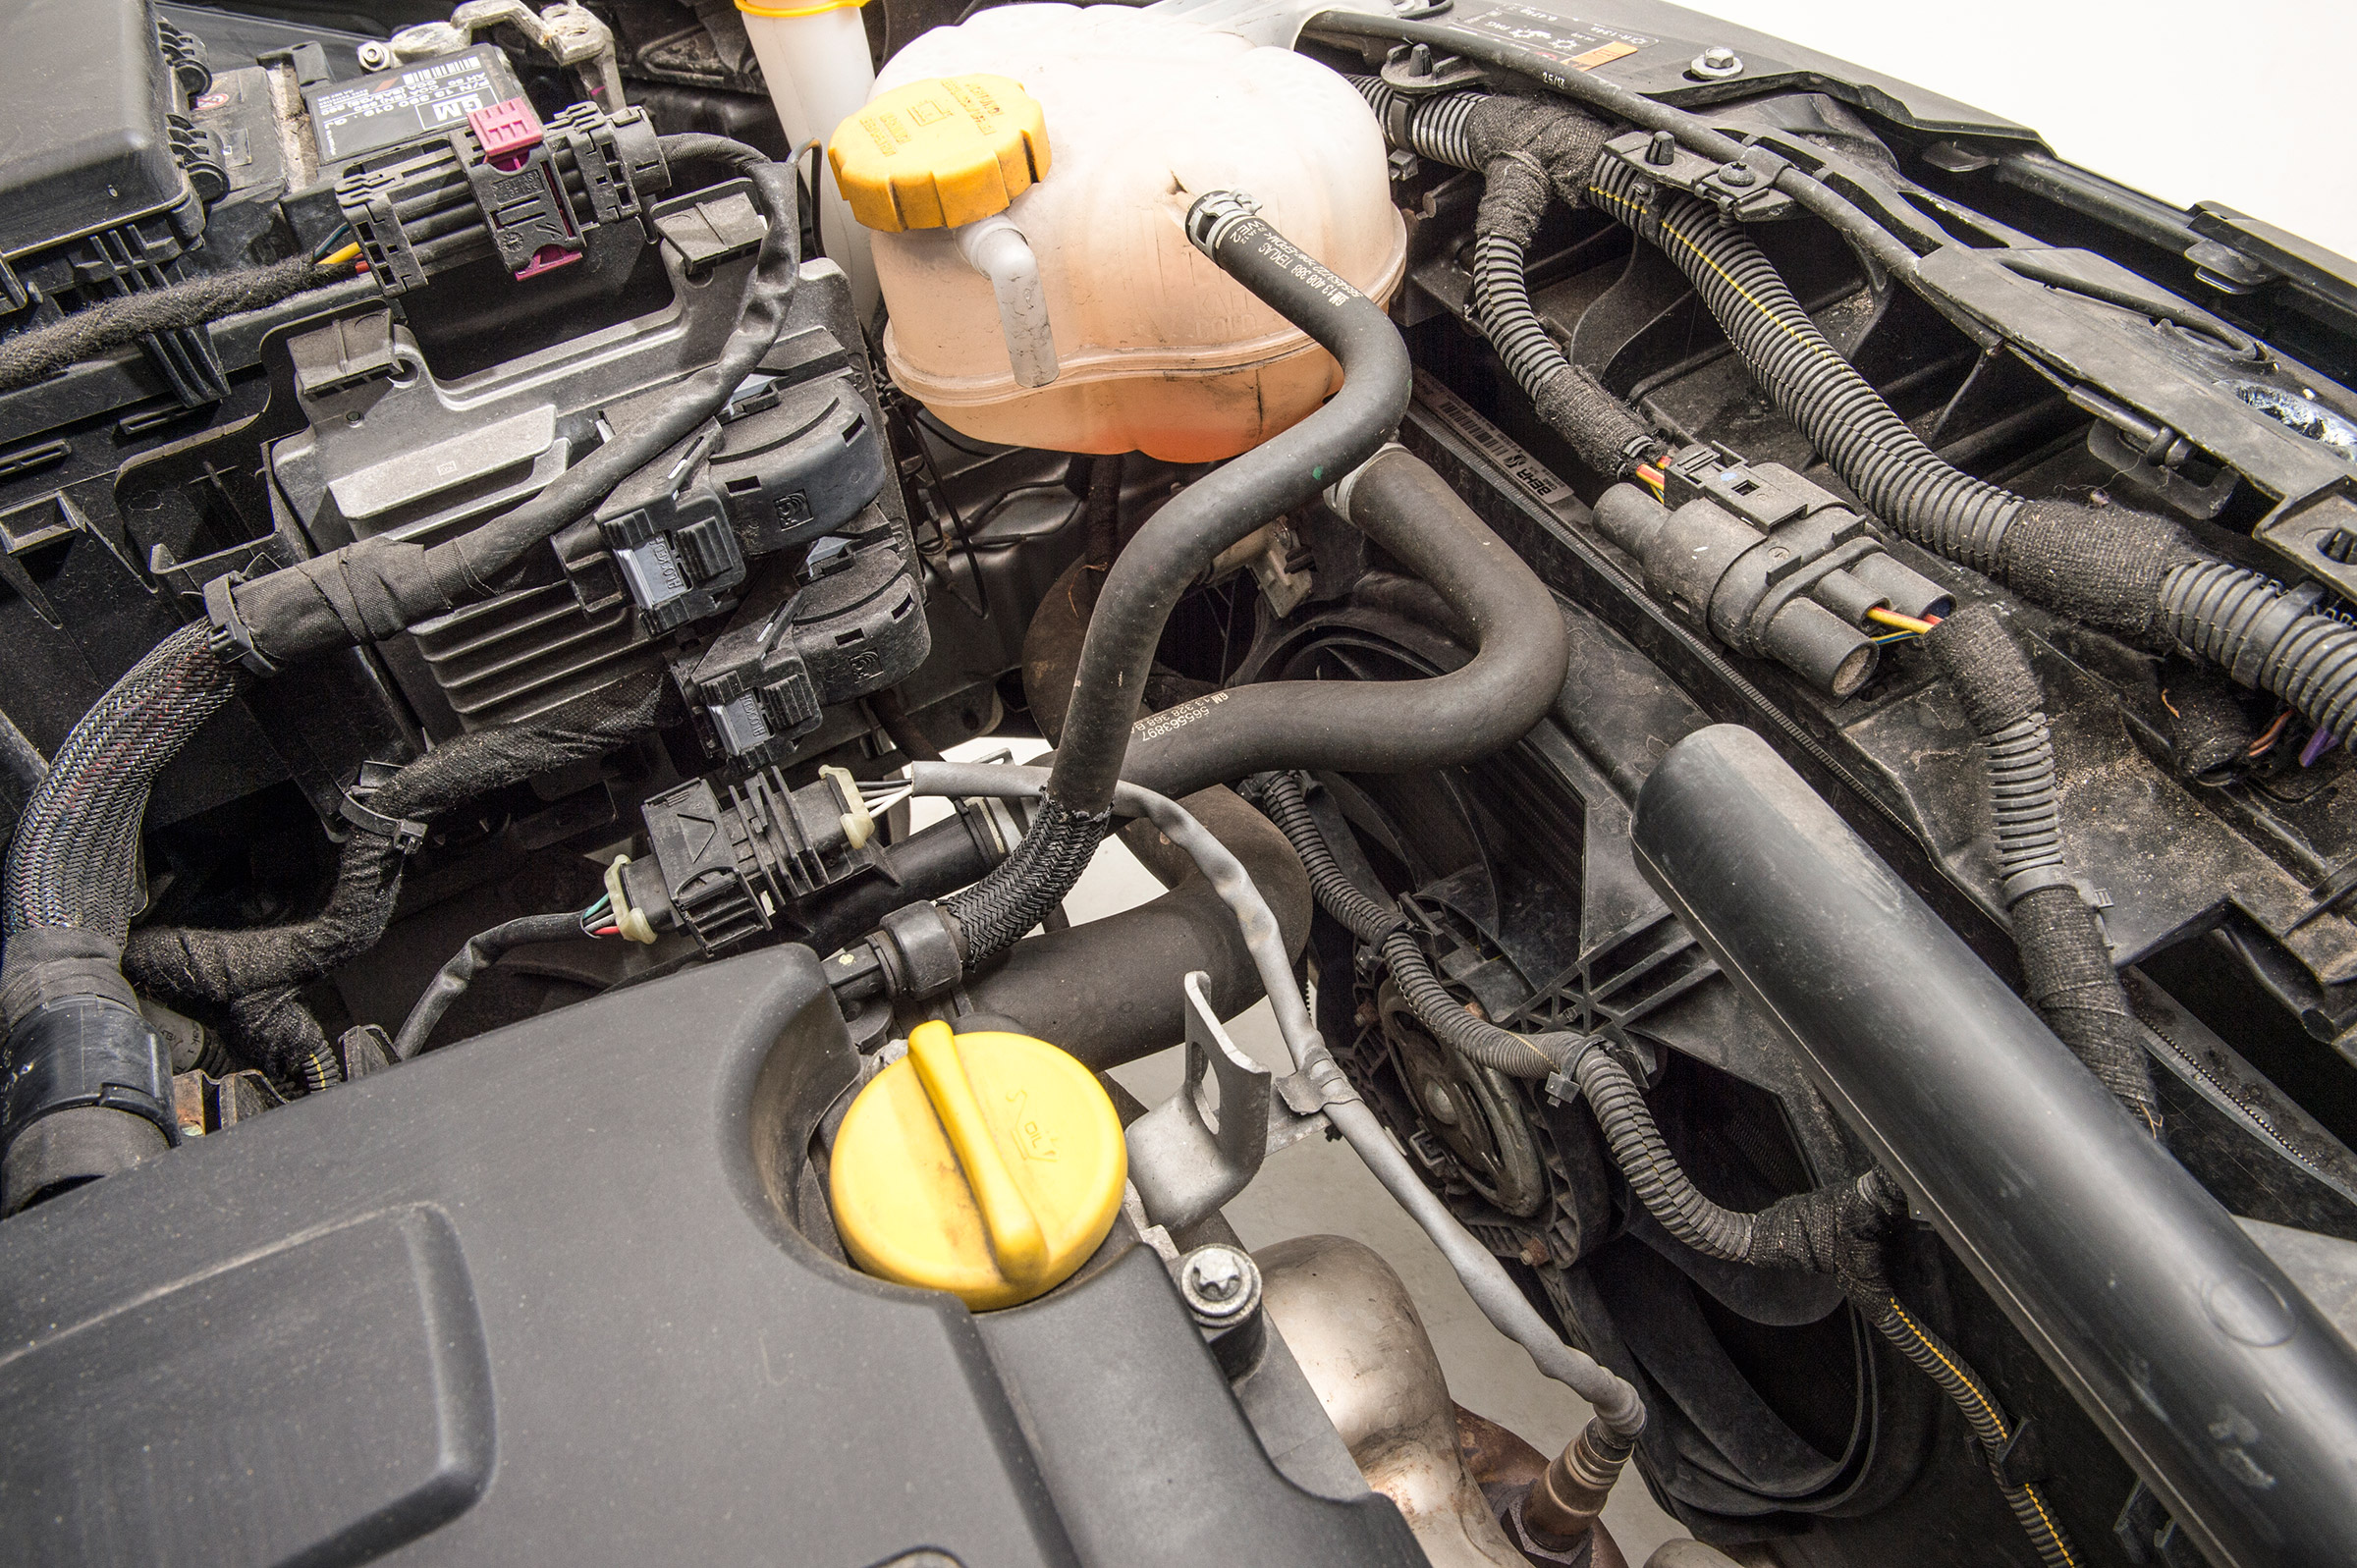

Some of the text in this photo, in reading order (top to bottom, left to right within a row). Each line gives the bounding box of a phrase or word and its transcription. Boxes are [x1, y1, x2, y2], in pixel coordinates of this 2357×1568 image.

[461, 79, 490, 92] P/N
[432, 94, 484, 122] GM
[1258, 242, 1293, 269] TEKLAS
[1516, 468, 1553, 496] BEHR
[1142, 706, 1210, 741] 565563897
[1147, 713, 1171, 727] 368
[1171, 703, 1194, 717] 328
[1024, 1120, 1042, 1149] OIL
